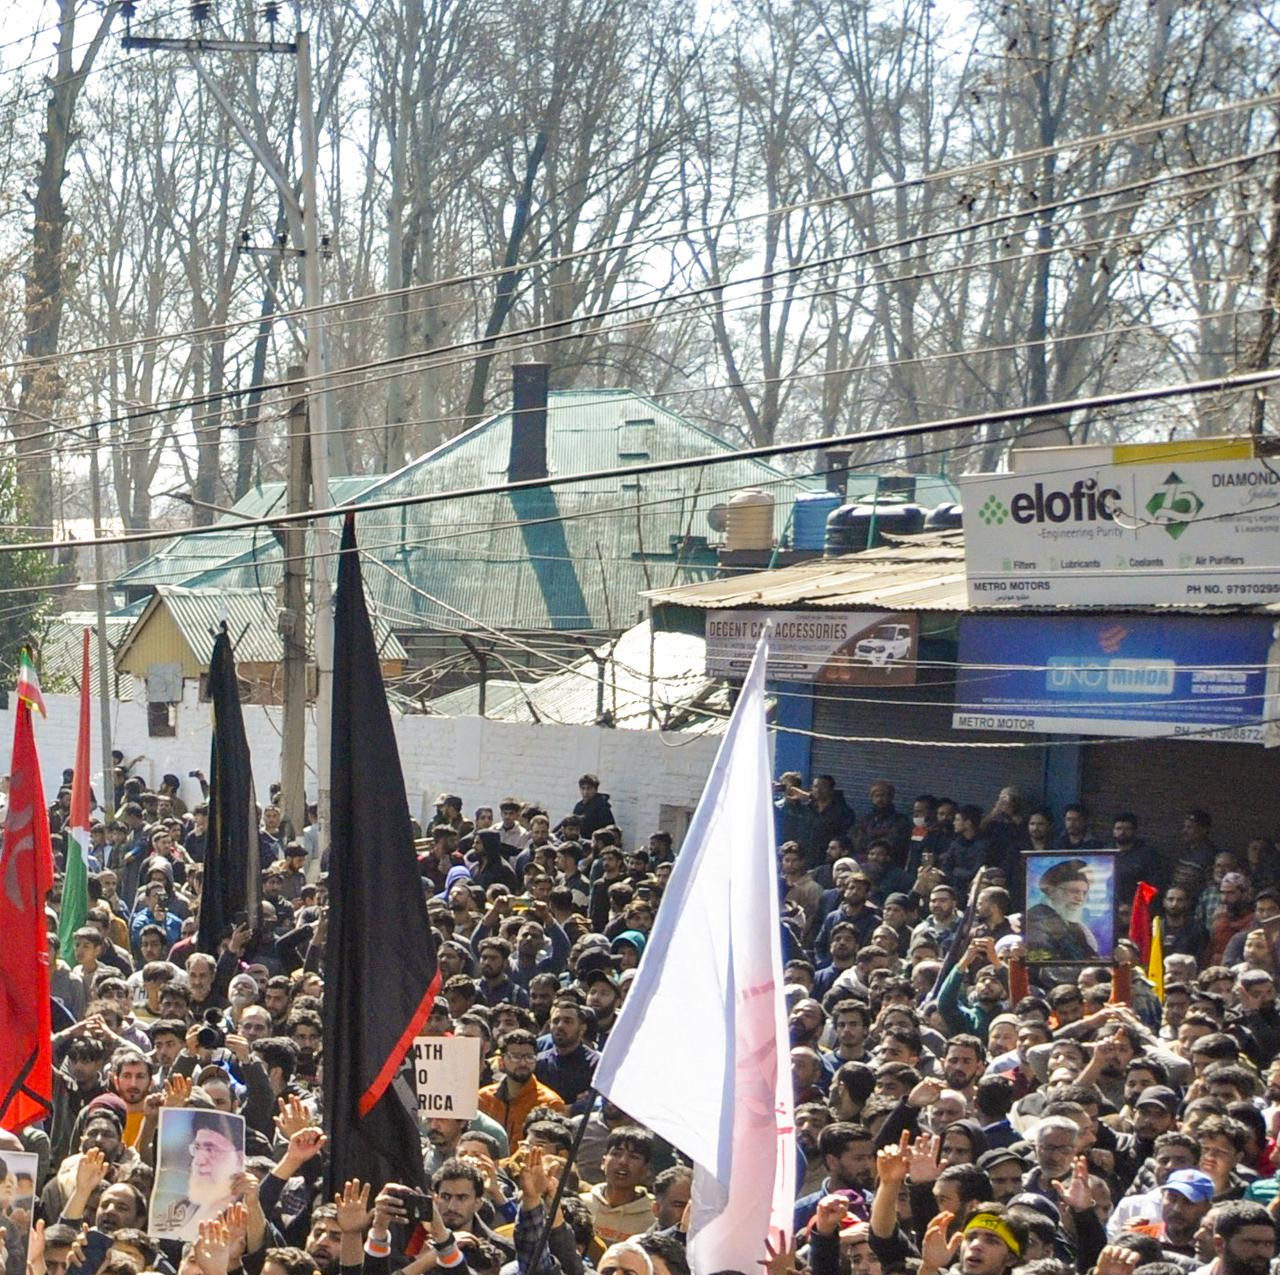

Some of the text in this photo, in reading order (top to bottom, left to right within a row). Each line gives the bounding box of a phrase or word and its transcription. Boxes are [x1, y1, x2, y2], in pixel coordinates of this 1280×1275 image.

[1212, 471, 1280, 488] DIAMOND
[1011, 477, 1122, 524] elofic
[1013, 560, 1037, 570] Filters
[1060, 559, 1101, 569] Lubricants
[1129, 557, 1164, 567] Coolants
[1195, 555, 1244, 566] Air Purifiers
[973, 581, 1051, 591] METRO MOTORS
[1187, 585, 1201, 594] PH
[709, 621, 747, 637] DECENT
[775, 622, 848, 640] ACCESSORIES
[1051, 661, 1104, 688] UNO
[1112, 666, 1170, 688] MINDA
[958, 715, 1036, 730] METRO MOTOR
[415, 1044, 443, 1060] ATH
[418, 1069, 428, 1085] O
[418, 1094, 453, 1111] RICA
